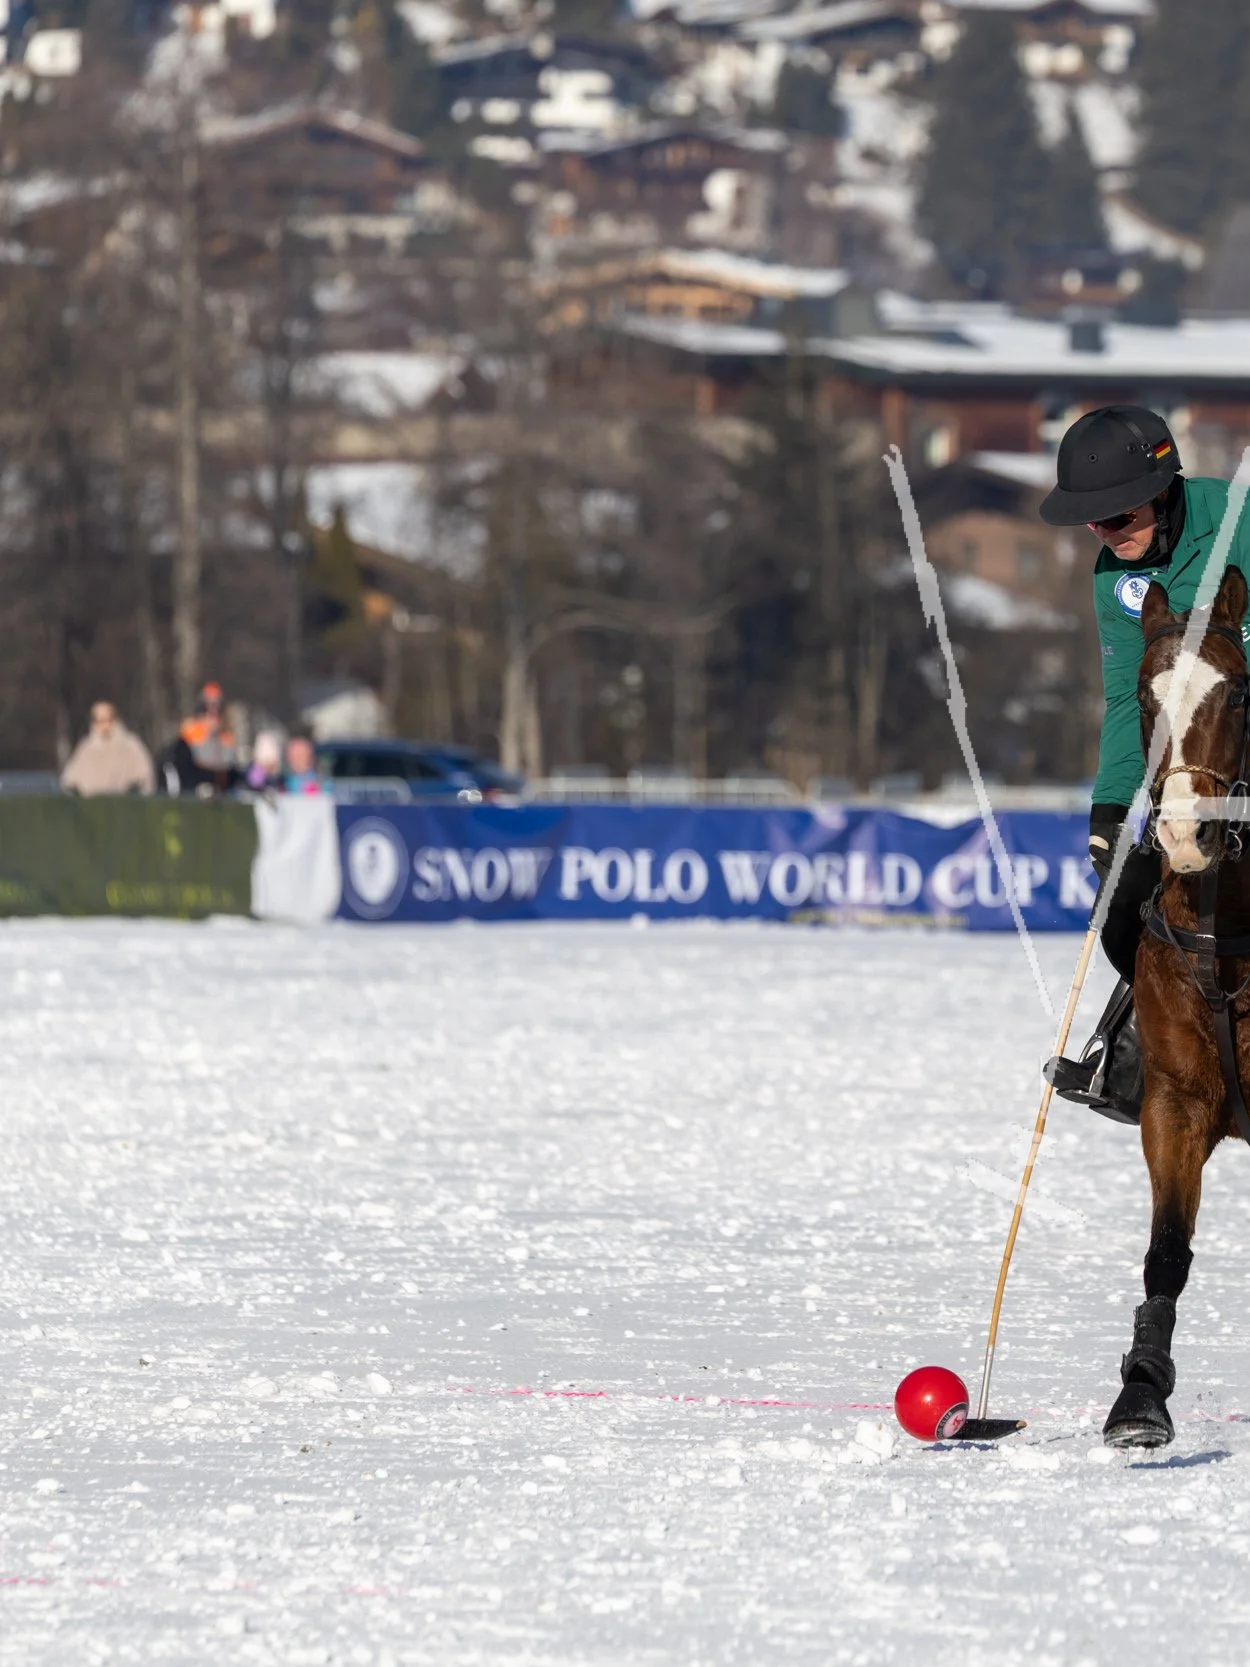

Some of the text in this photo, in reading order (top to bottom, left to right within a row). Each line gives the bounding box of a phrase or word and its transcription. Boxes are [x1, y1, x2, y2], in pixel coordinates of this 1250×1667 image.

[412, 845, 552, 901] SNOW
[560, 846, 709, 904] POLO
[716, 850, 922, 907] WORLD
[932, 853, 1050, 909] CUP
